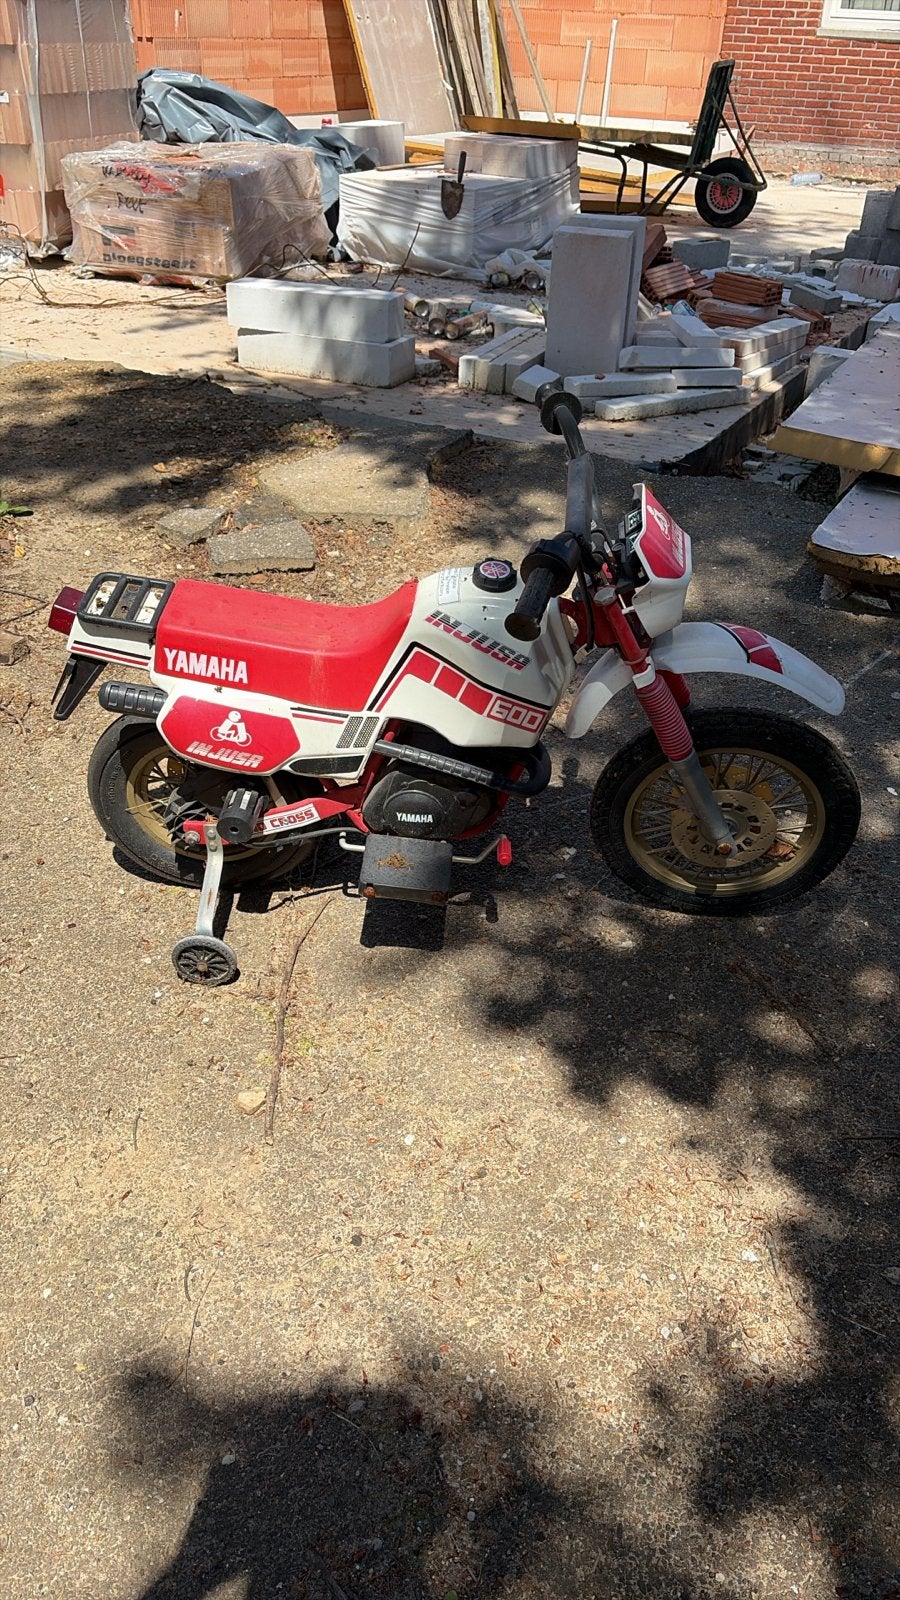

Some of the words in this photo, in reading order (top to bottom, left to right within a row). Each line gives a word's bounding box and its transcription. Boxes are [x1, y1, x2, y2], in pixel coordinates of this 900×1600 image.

[424, 610, 531, 671] INJUSA
[163, 647, 249, 684] YAMAHA
[491, 698, 543, 729] 600
[186, 741, 264, 768] INJUSA
[269, 808, 315, 828] CROSS
[396, 811, 434, 823] YAMAHA
